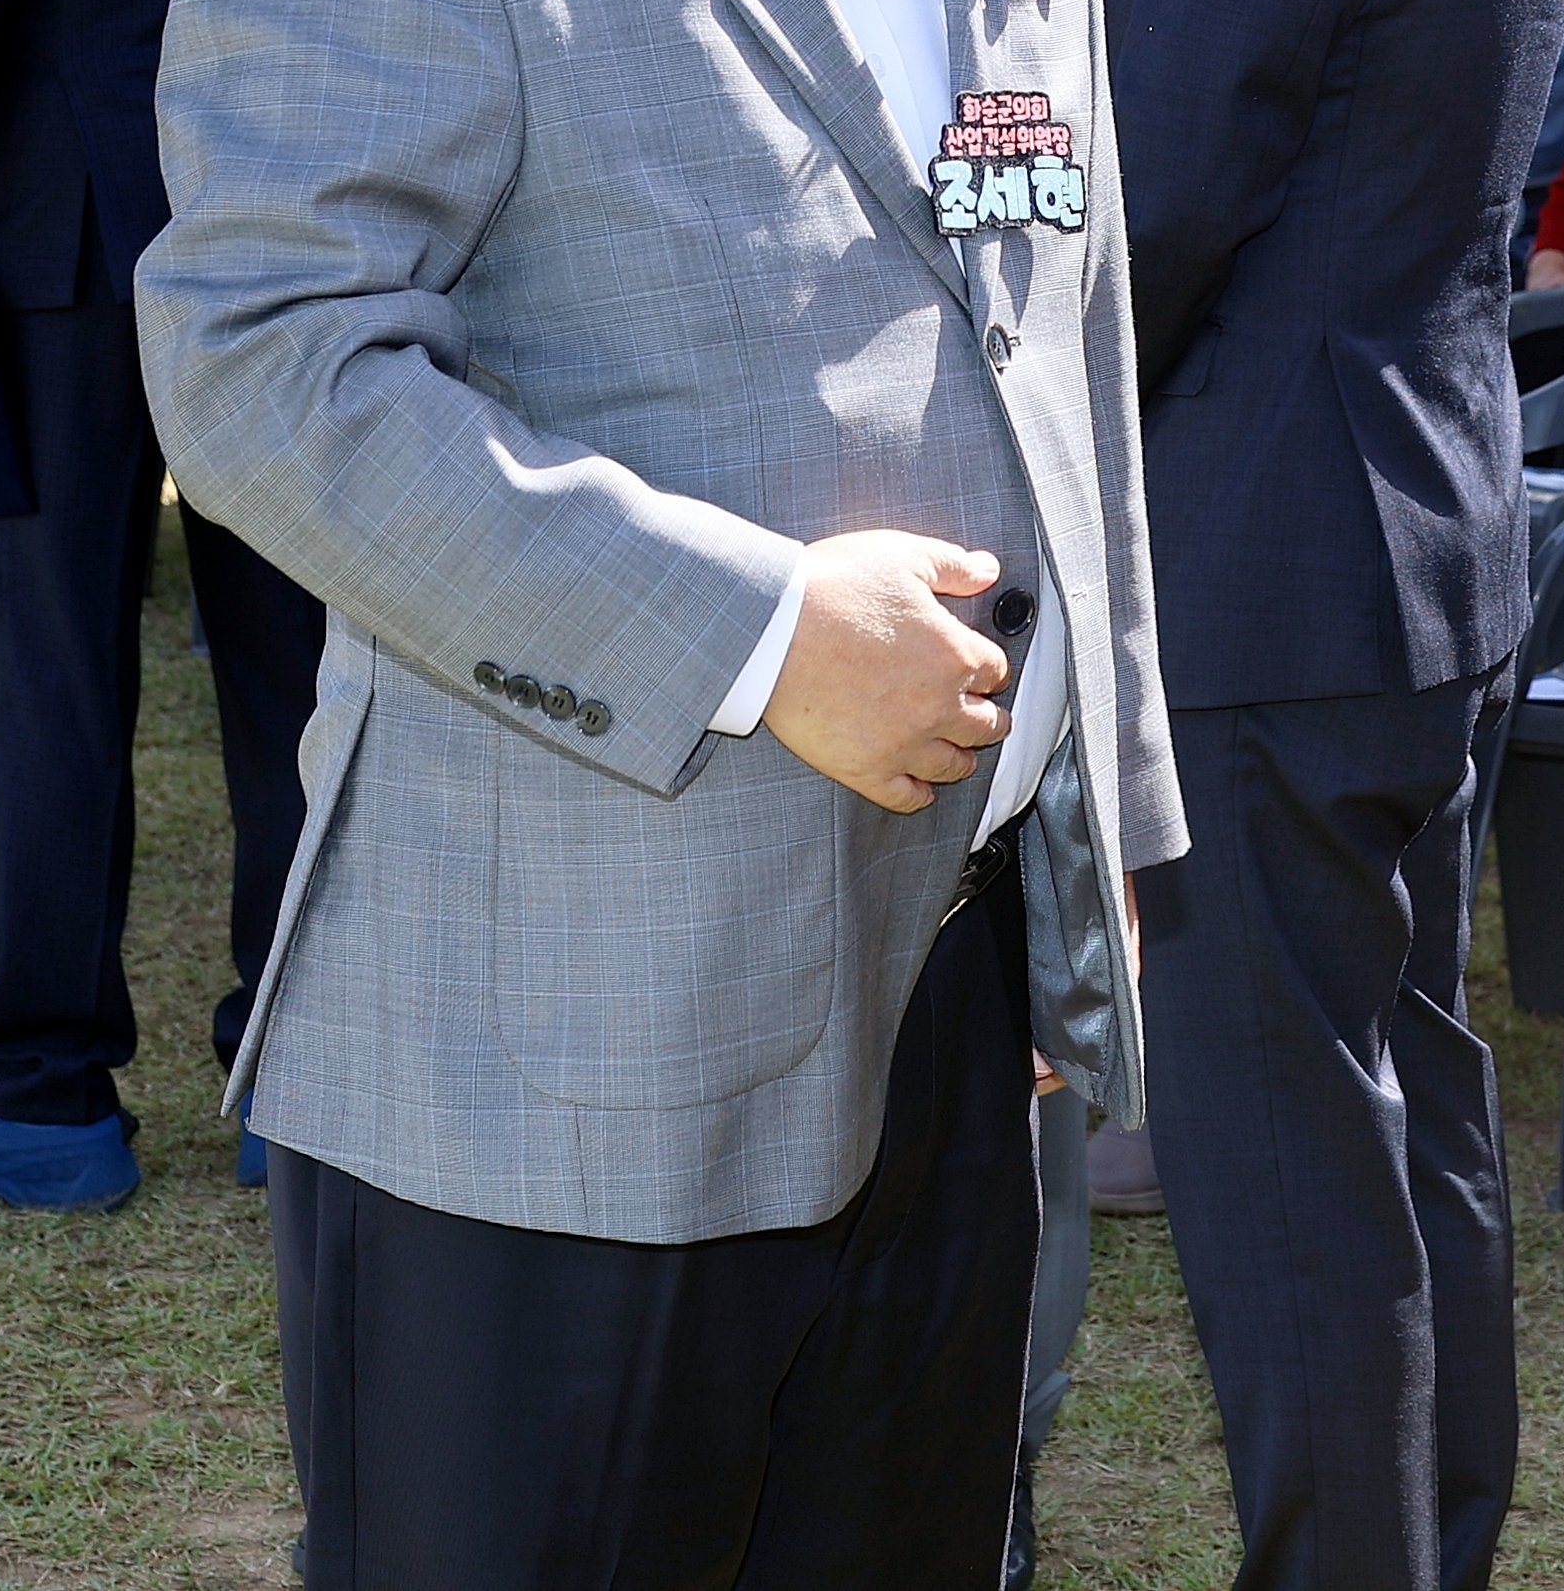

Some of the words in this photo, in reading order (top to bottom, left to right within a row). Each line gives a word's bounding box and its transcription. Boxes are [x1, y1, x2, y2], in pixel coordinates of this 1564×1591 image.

[961, 93, 1049, 125] 화순군의회
[945, 125, 1071, 157] 산업건설위원장
[934, 155, 1085, 229] 조세현
